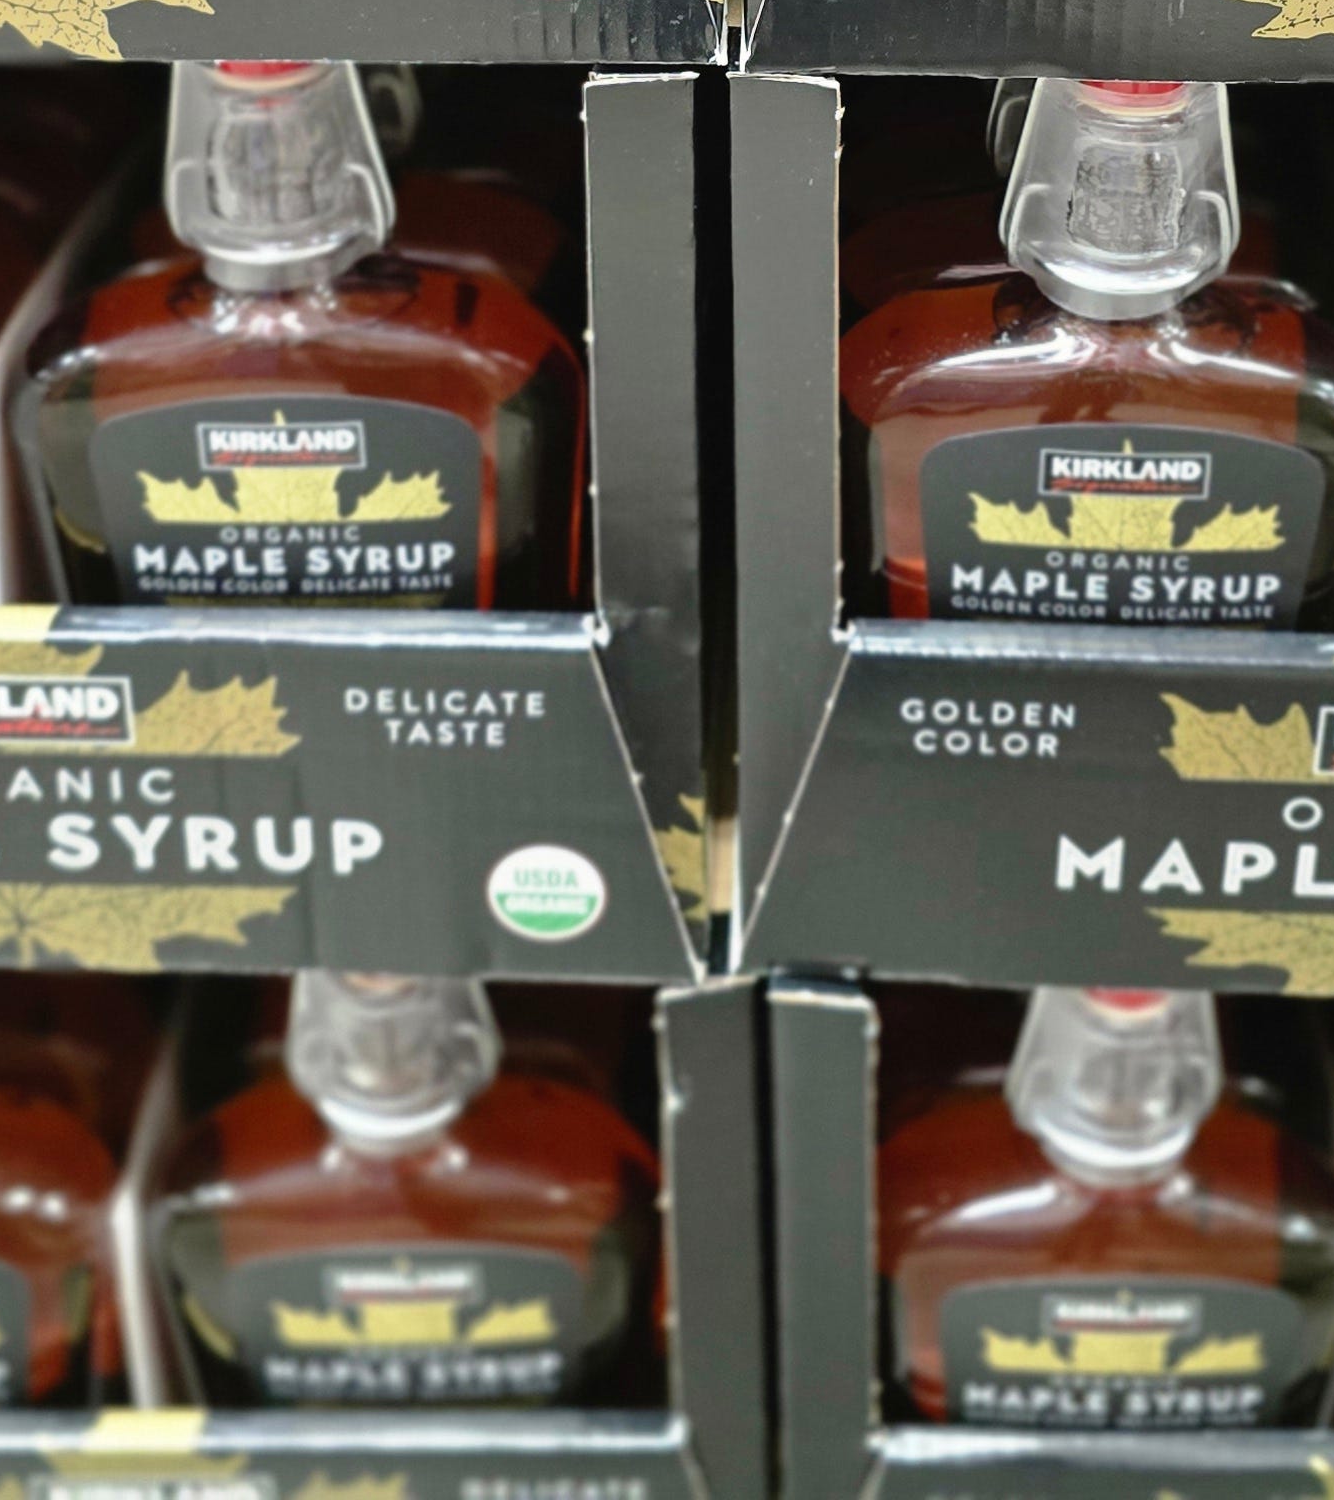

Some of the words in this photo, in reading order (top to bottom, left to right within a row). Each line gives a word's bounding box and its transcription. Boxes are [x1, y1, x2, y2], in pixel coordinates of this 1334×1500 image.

[210, 430, 355, 452] KIRKLAND
[1051, 456, 1201, 480] KIRKLAND
[221, 527, 360, 543] ORGANIC
[135, 546, 286, 574] MAPLE
[307, 543, 454, 574] SYRUP
[1047, 551, 1189, 571] ORGANIC
[139, 577, 215, 591] GOLDEN
[399, 575, 453, 590] TASTE
[952, 565, 1109, 599] MAPLE
[1130, 575, 1279, 601] SYRUP
[952, 595, 1032, 615] GOLDEN
[1039, 600, 1107, 617] COLOR
[1121, 606, 1210, 620] DELICATE
[1220, 605, 1273, 619] TASTE
[346, 690, 545, 717] DELICATE
[900, 699, 1075, 726] GOLDEN
[385, 720, 504, 746] TASTE
[914, 729, 1059, 757] COLOR
[47, 812, 382, 874] SYRUP
